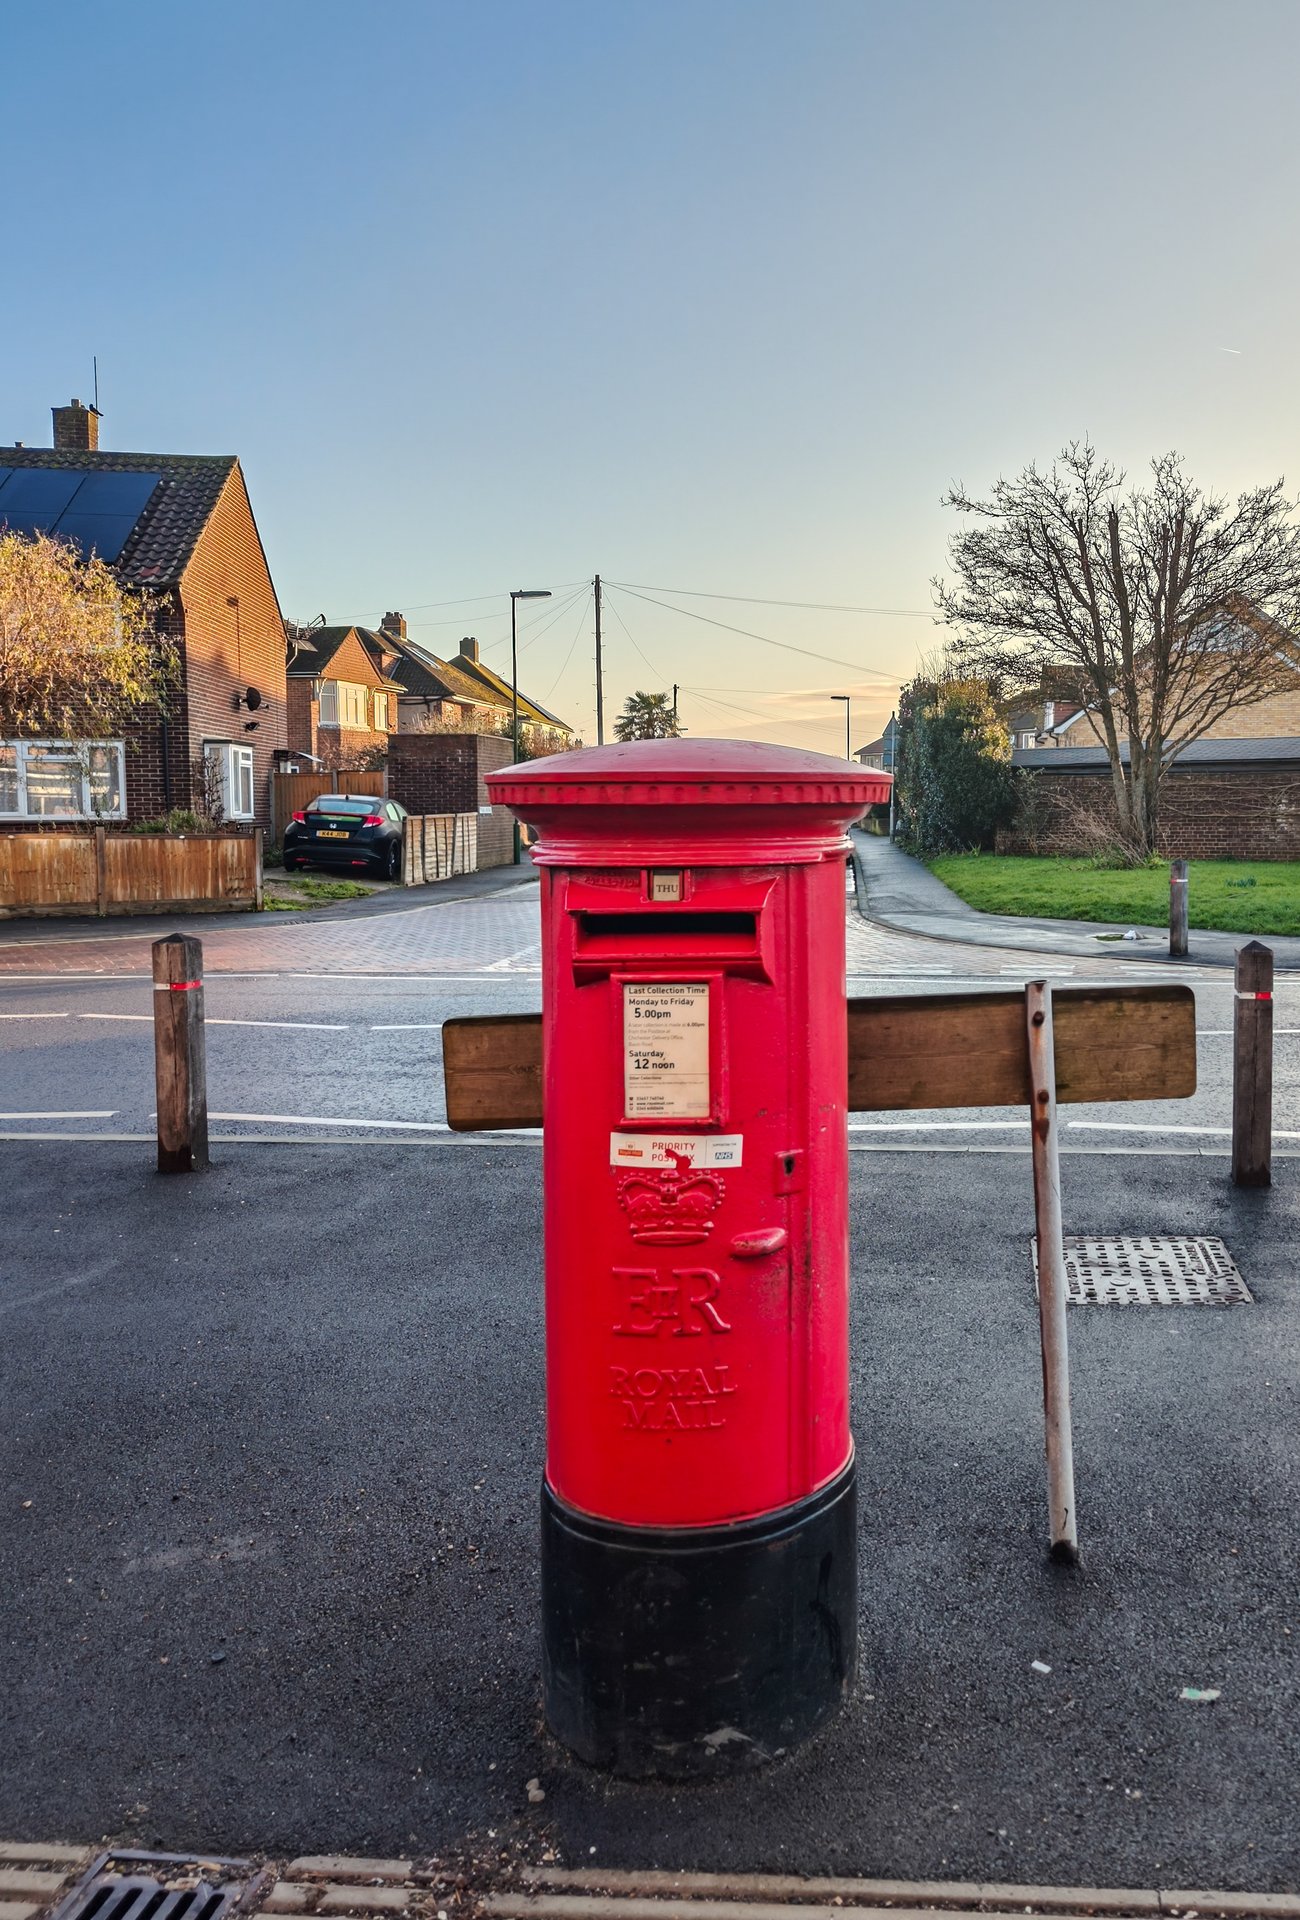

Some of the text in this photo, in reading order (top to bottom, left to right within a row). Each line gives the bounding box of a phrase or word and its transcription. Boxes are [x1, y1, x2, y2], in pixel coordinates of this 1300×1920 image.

[655, 884, 679, 893] THU
[628, 998, 659, 1006] Monday
[670, 998, 694, 1006] Friday
[634, 1007, 672, 1019] 5.00pm
[628, 1050, 665, 1058] Saturday
[634, 1058, 650, 1070] 12
[651, 1142, 696, 1151] PRIORITY
[651, 1153, 695, 1162] POSX
[715, 1152, 733, 1160] NHS
[609, 1366, 739, 1397] ROYAL
[622, 1400, 727, 1430] MAIL
